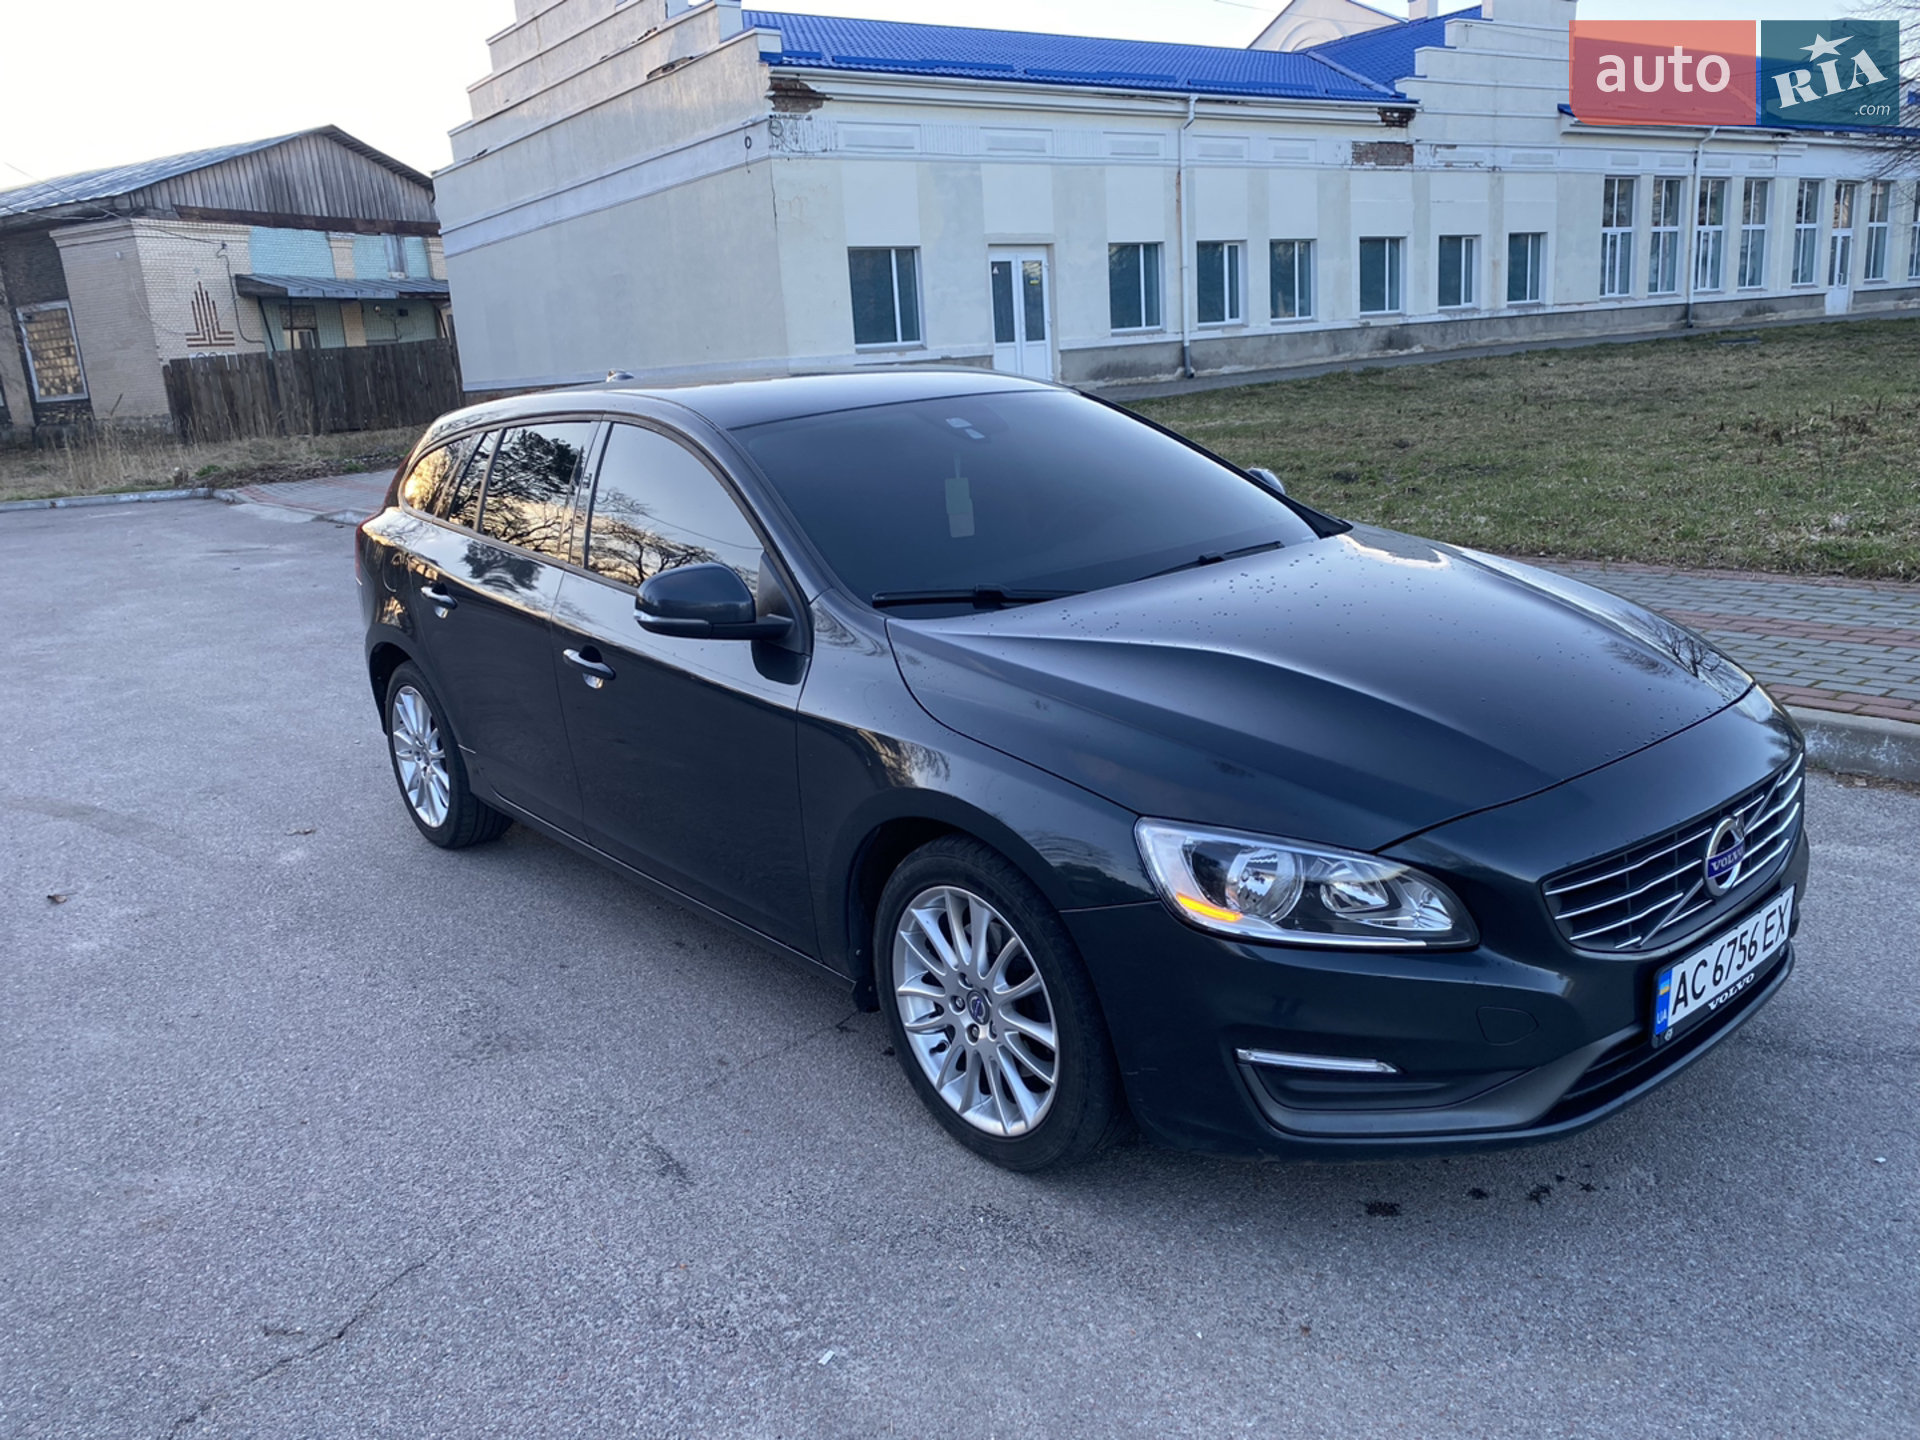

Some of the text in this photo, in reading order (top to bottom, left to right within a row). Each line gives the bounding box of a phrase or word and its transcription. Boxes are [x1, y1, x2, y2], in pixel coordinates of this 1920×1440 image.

[1672, 898, 1789, 1016] AC 6756 EX
[1708, 973, 1755, 1010] VOLVO
[1657, 1009, 1667, 1024] UA
